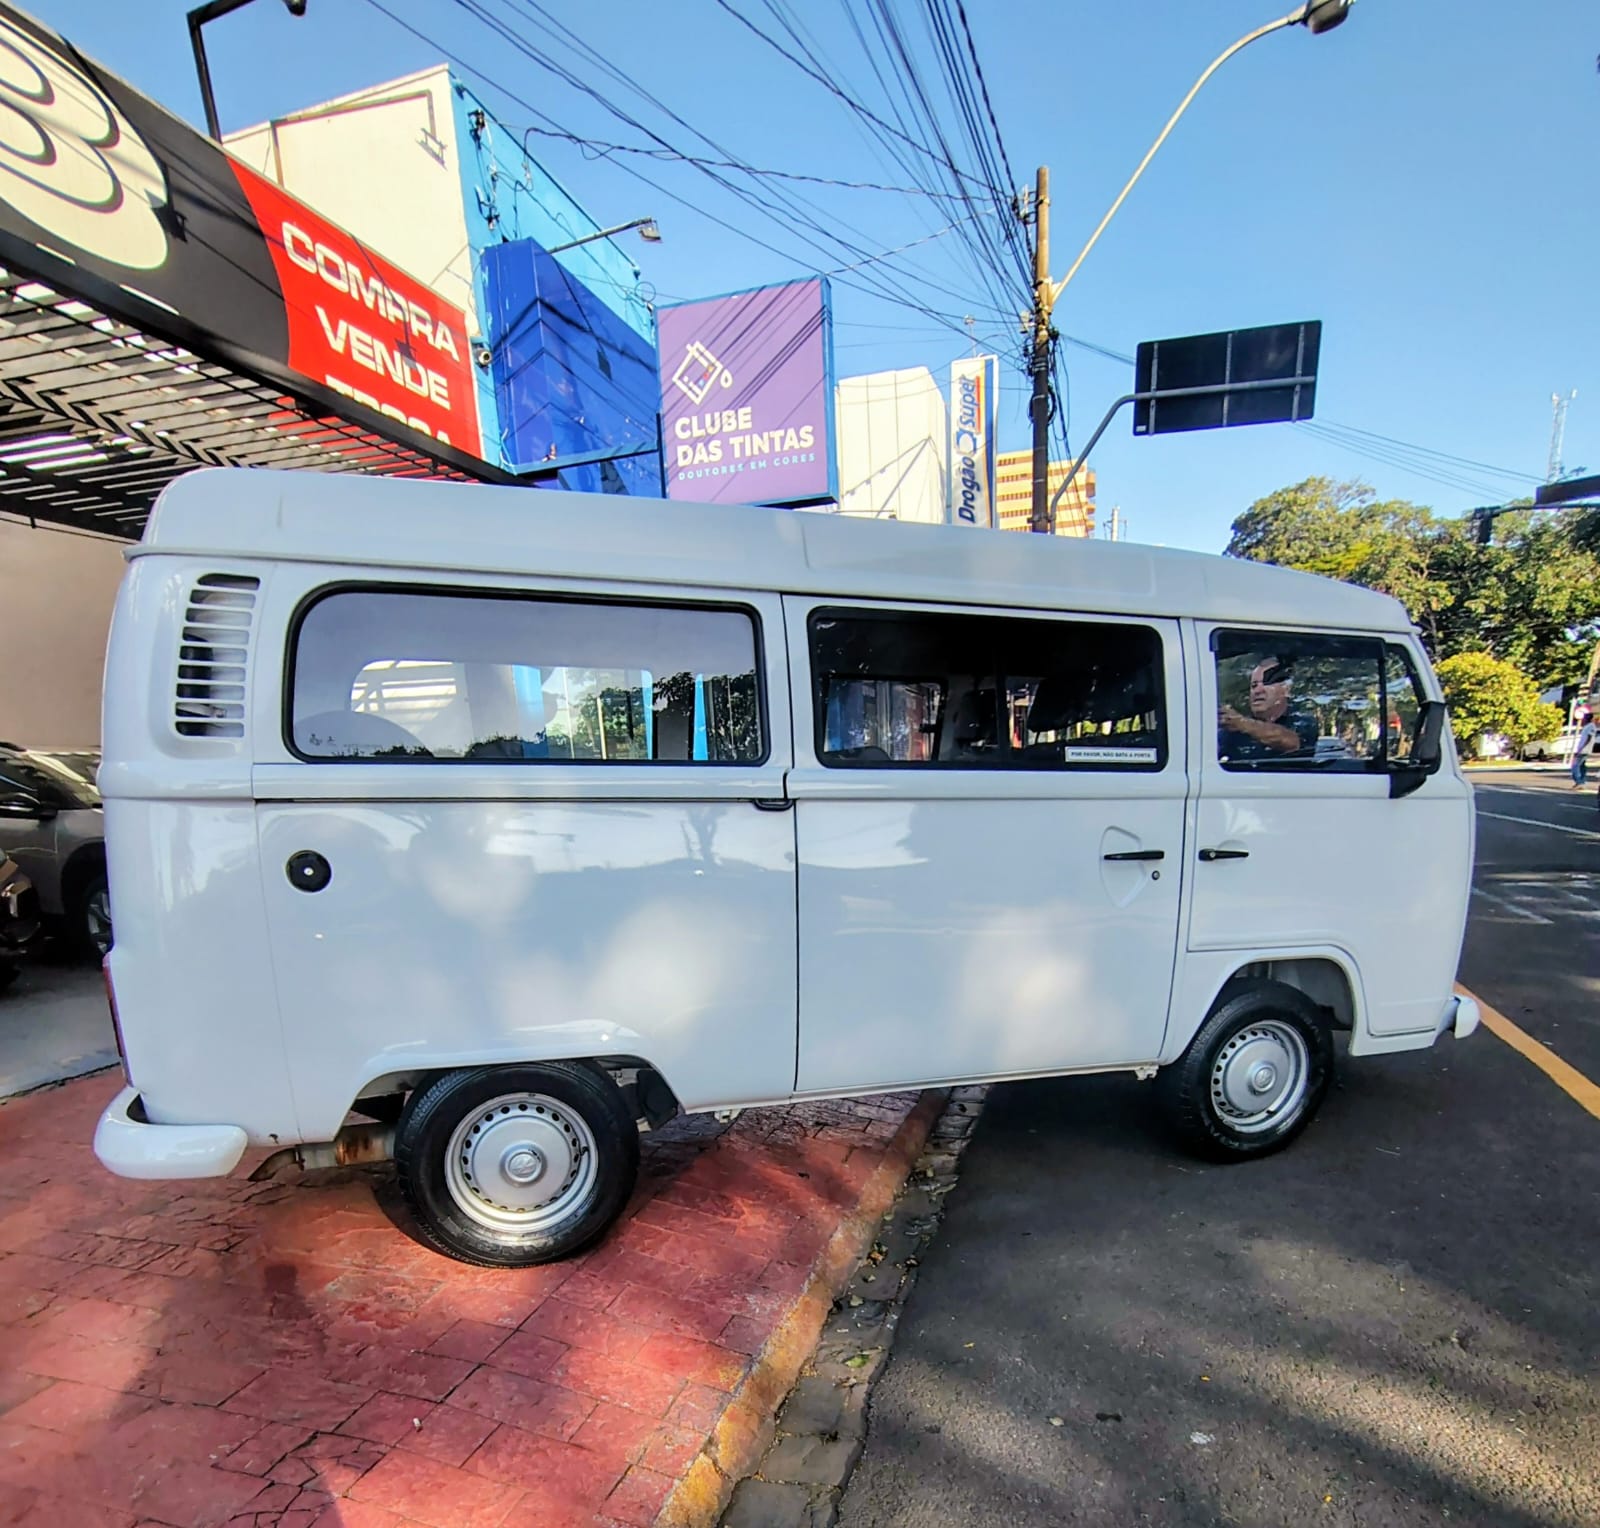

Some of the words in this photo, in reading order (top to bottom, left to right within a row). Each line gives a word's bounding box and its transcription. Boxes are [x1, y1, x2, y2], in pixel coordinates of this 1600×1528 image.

[282, 221, 460, 362] COMPRA
[315, 305, 451, 411] VENDE
[675, 407, 752, 439] CLUBE
[677, 439, 723, 467] DAS
[729, 425, 815, 459] TINTAS
[678, 463, 745, 480] DOUTORES
[750, 460, 767, 470] EM
[773, 453, 816, 466] CORES
[956, 456, 981, 523] Drogão
